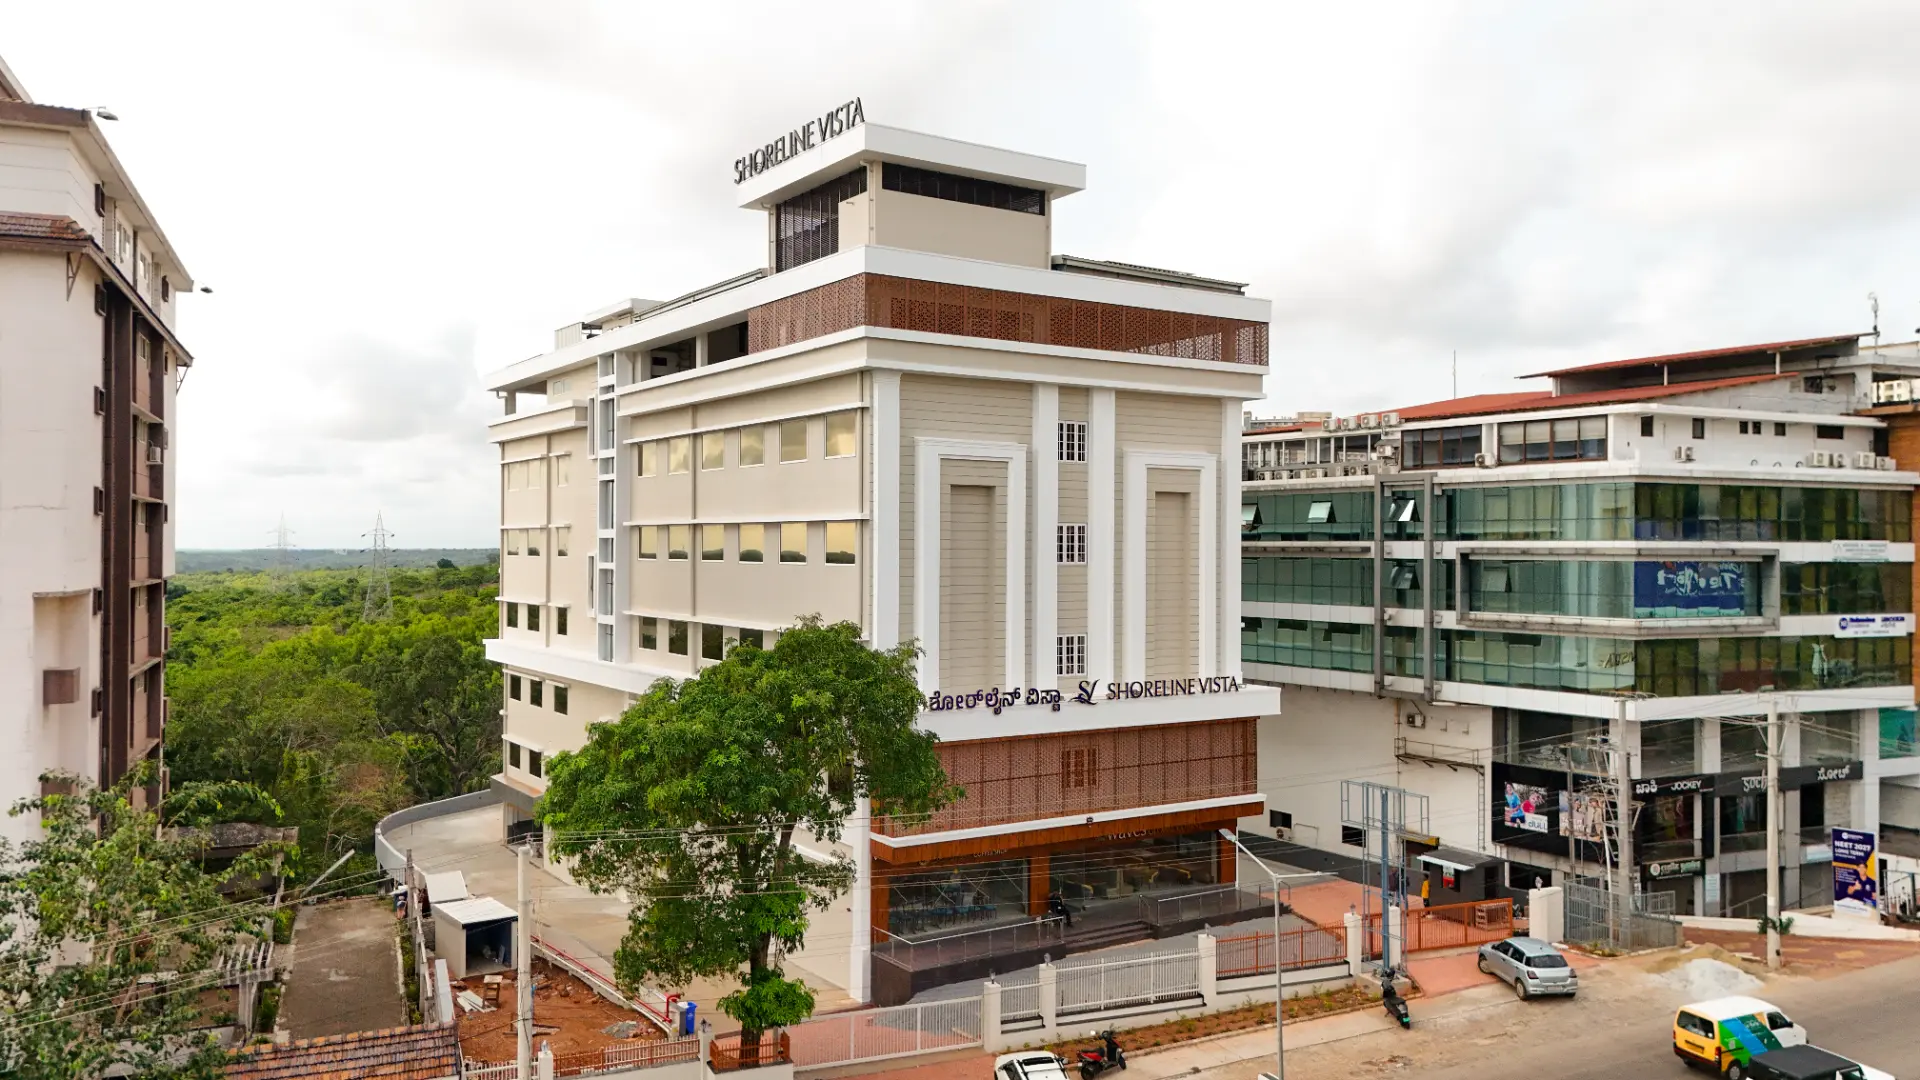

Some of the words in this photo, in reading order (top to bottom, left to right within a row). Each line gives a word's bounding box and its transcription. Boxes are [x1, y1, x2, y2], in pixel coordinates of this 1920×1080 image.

[734, 120, 815, 184] SHORELINE
[817, 97, 865, 142] VISTA
[1107, 678, 1195, 700] SHORELINE
[1198, 676, 1239, 694] VISTA
[1670, 780, 1701, 791] JOCKEY
[1834, 840, 1853, 849] NEET
